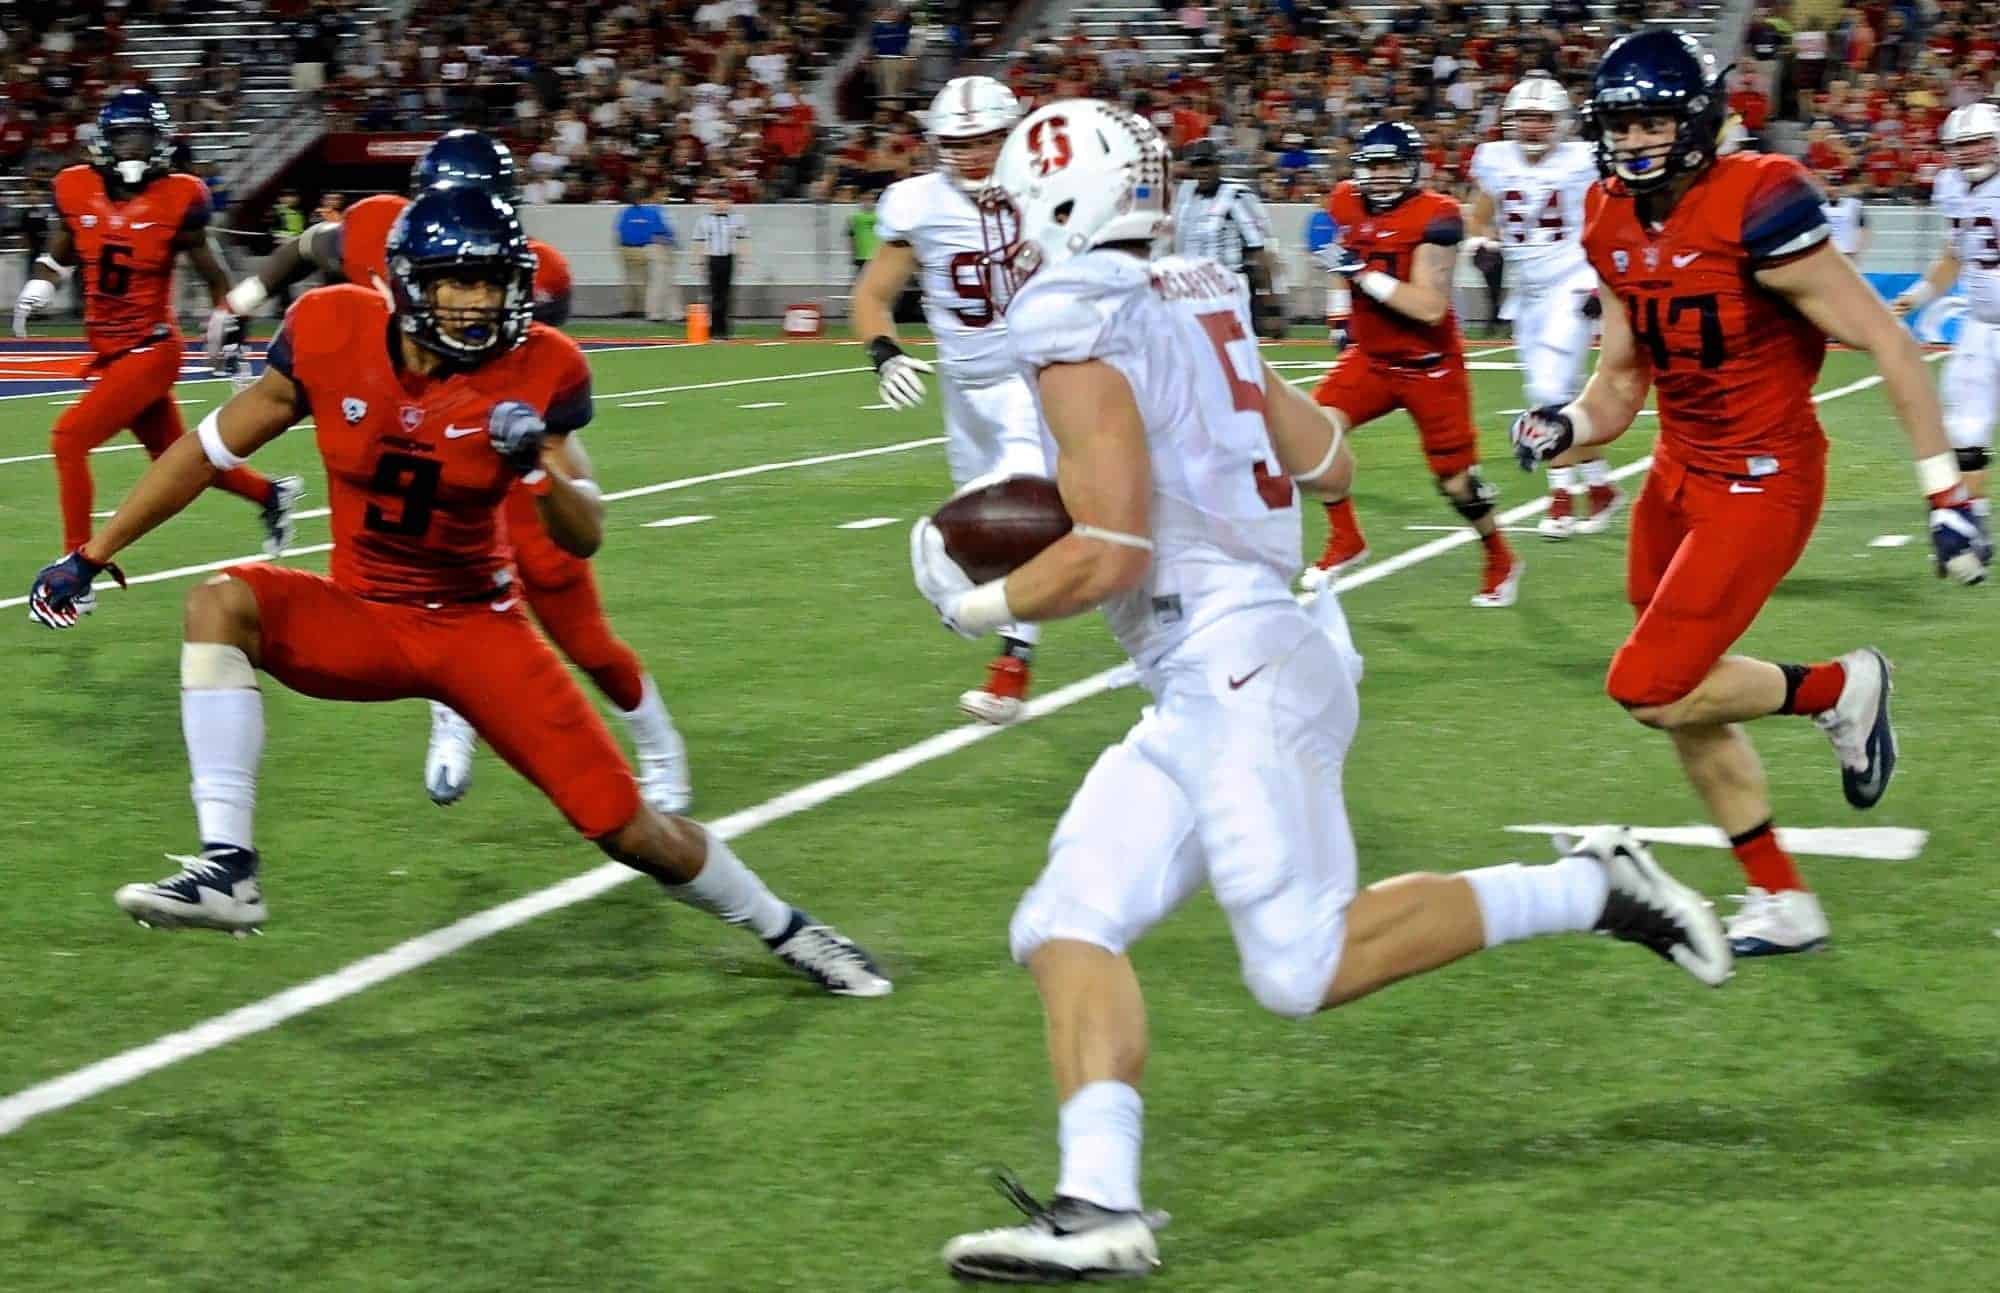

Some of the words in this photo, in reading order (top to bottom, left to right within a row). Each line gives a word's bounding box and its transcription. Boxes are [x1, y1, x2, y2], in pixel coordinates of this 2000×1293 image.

[100, 244, 133, 296] 6
[951, 251, 994, 328] 9
[1195, 310, 1293, 510] 5
[364, 453, 443, 536] 9
